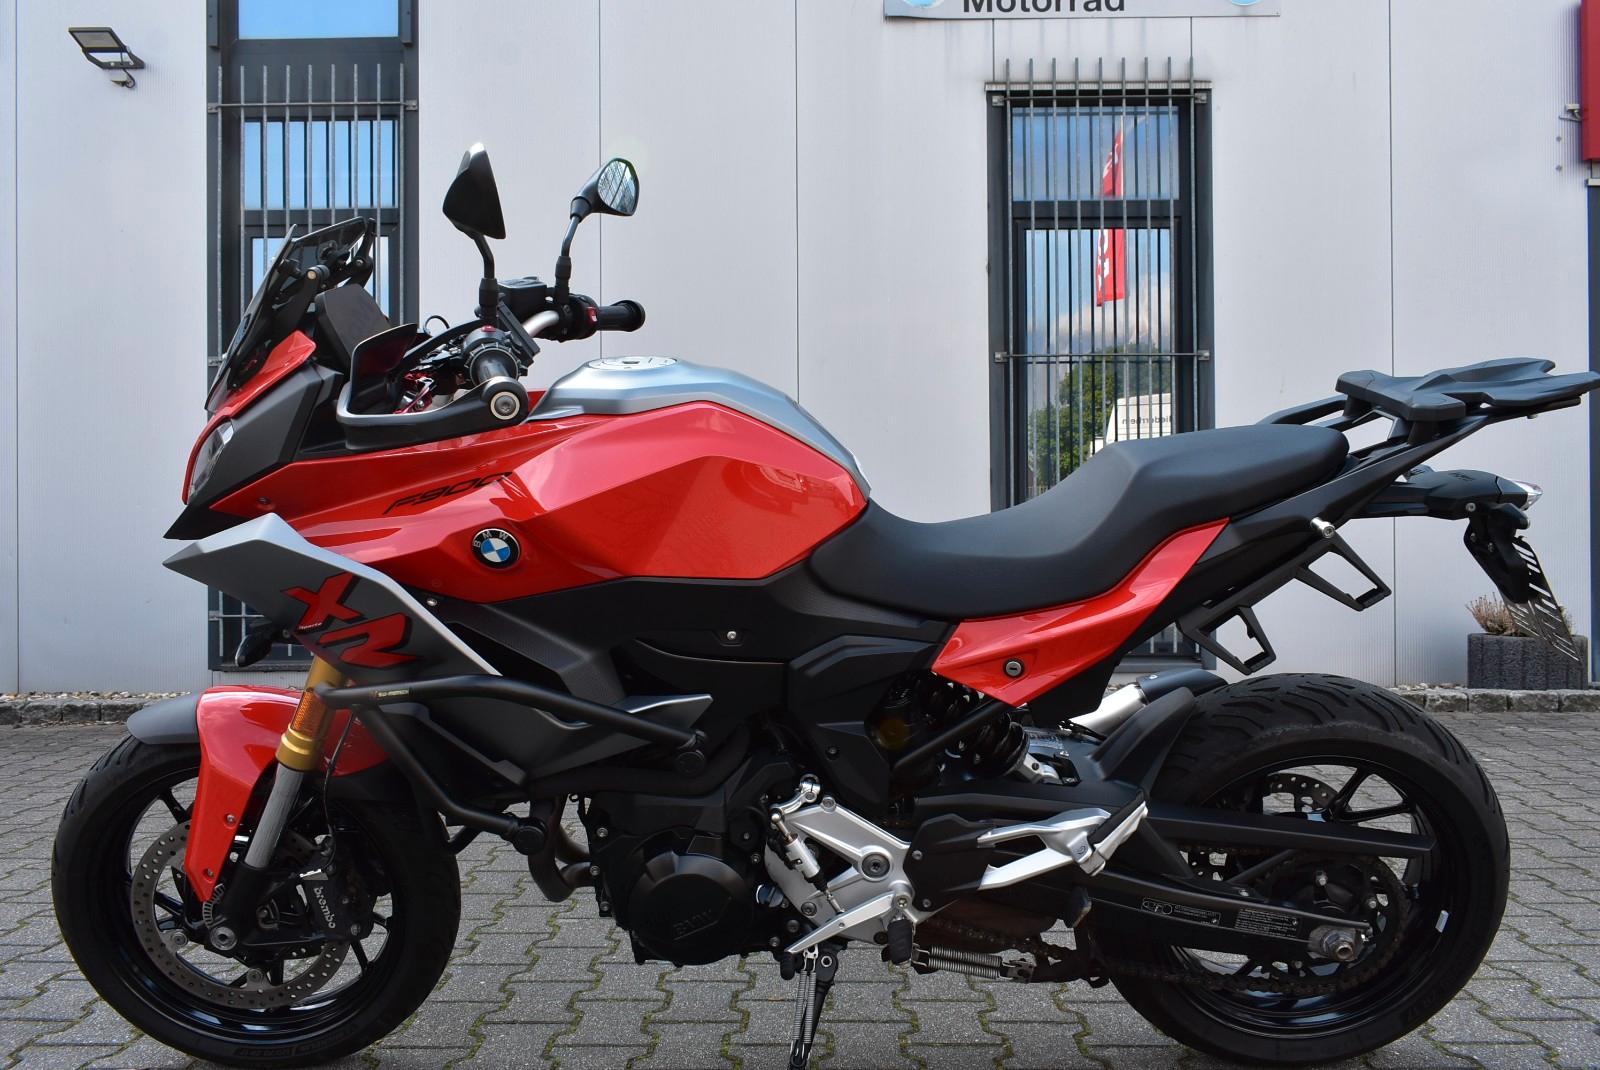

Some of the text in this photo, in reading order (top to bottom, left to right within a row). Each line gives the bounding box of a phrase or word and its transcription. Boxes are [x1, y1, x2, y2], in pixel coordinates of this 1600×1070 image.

[963, 0, 1125, 13] Motorrad
[472, 529, 510, 548] BMW
[313, 886, 336, 929] brembo
